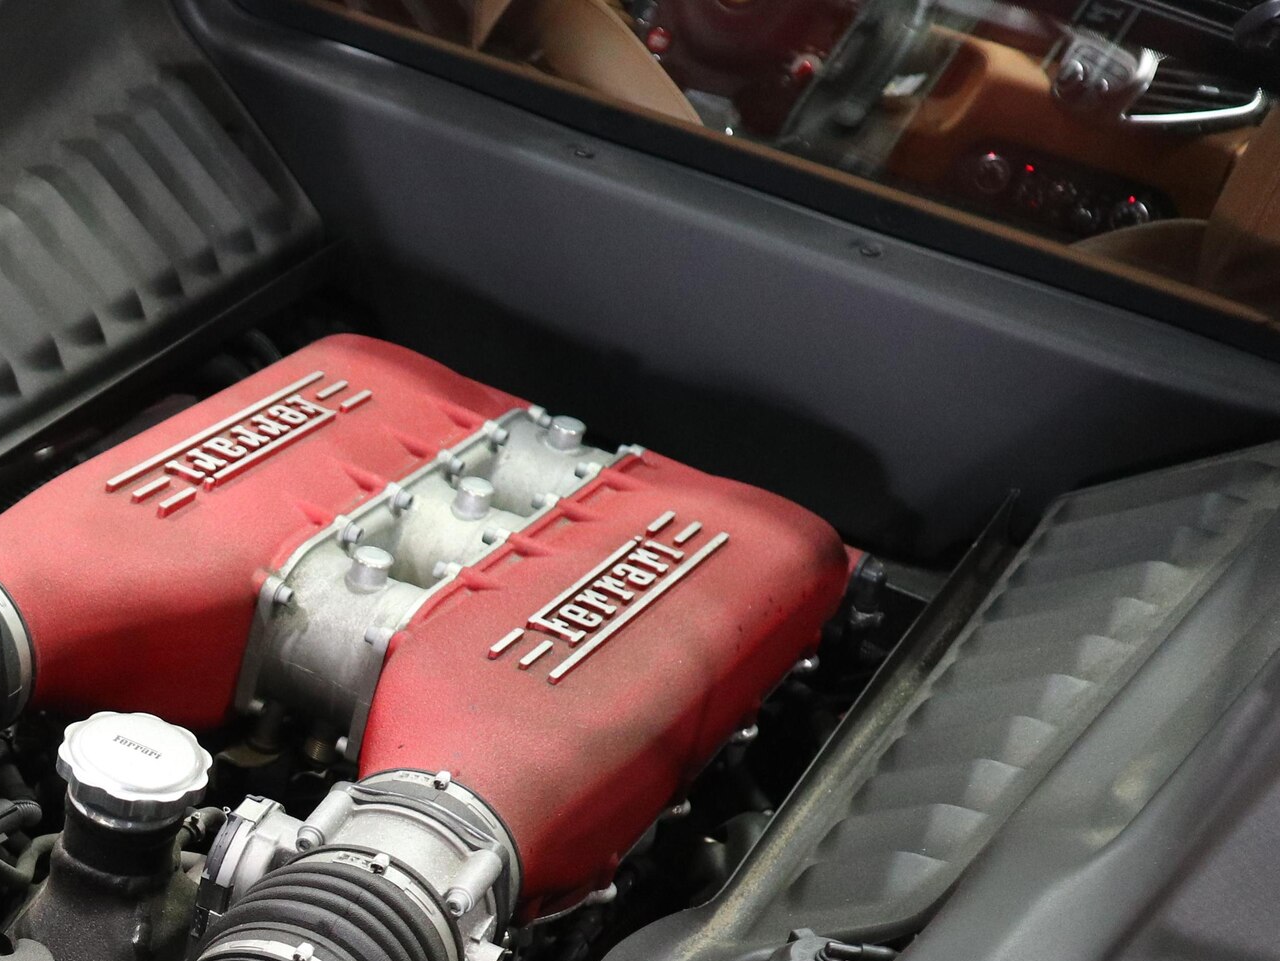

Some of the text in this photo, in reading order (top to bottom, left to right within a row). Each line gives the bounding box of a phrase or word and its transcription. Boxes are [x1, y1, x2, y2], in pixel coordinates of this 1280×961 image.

[164, 393, 336, 490] Ferrari
[527, 535, 685, 646] Ferrari
[113, 735, 163, 760] Ferrari
